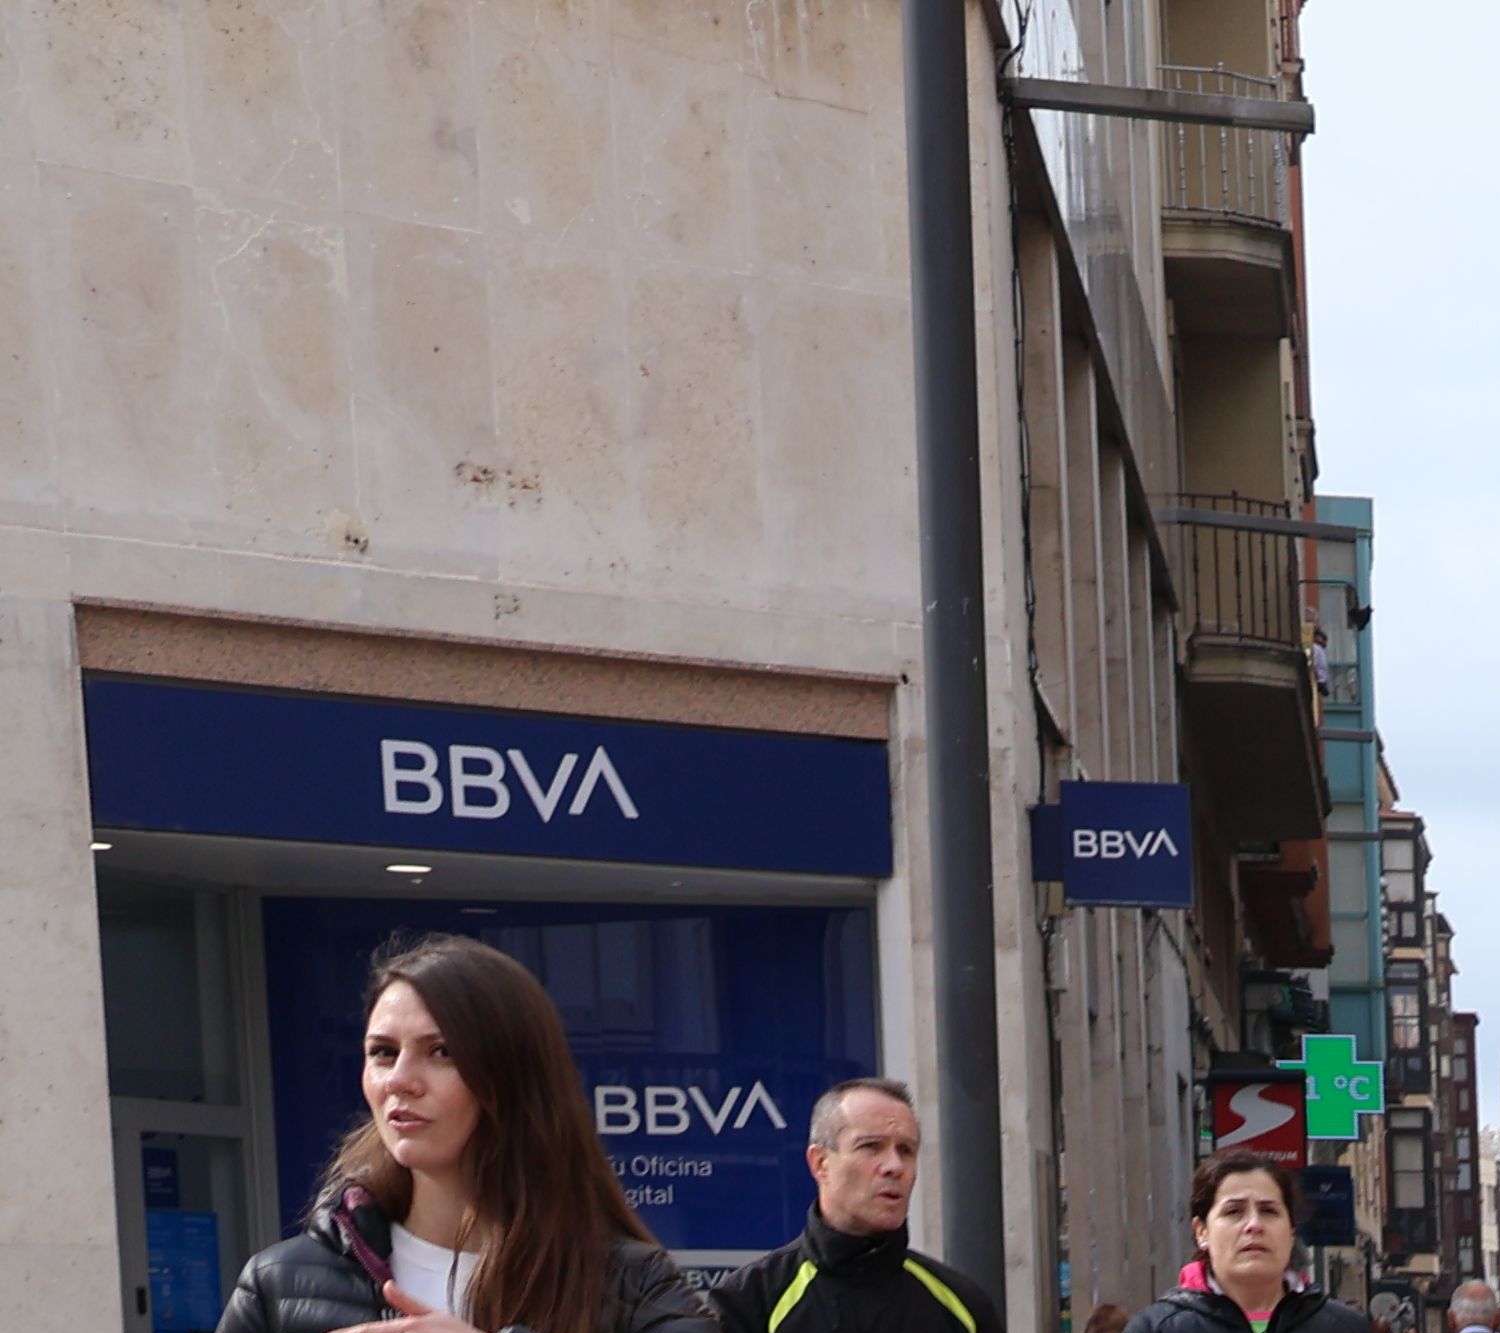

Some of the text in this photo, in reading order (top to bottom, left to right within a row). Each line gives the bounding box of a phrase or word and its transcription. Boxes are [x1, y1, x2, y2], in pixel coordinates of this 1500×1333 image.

[380, 739, 640, 824] BBVA
[1072, 828, 1179, 860] BBVA
[594, 1080, 788, 1136] BBVA
[631, 1155, 713, 1178] Oficina
[625, 1184, 674, 1208] gital
